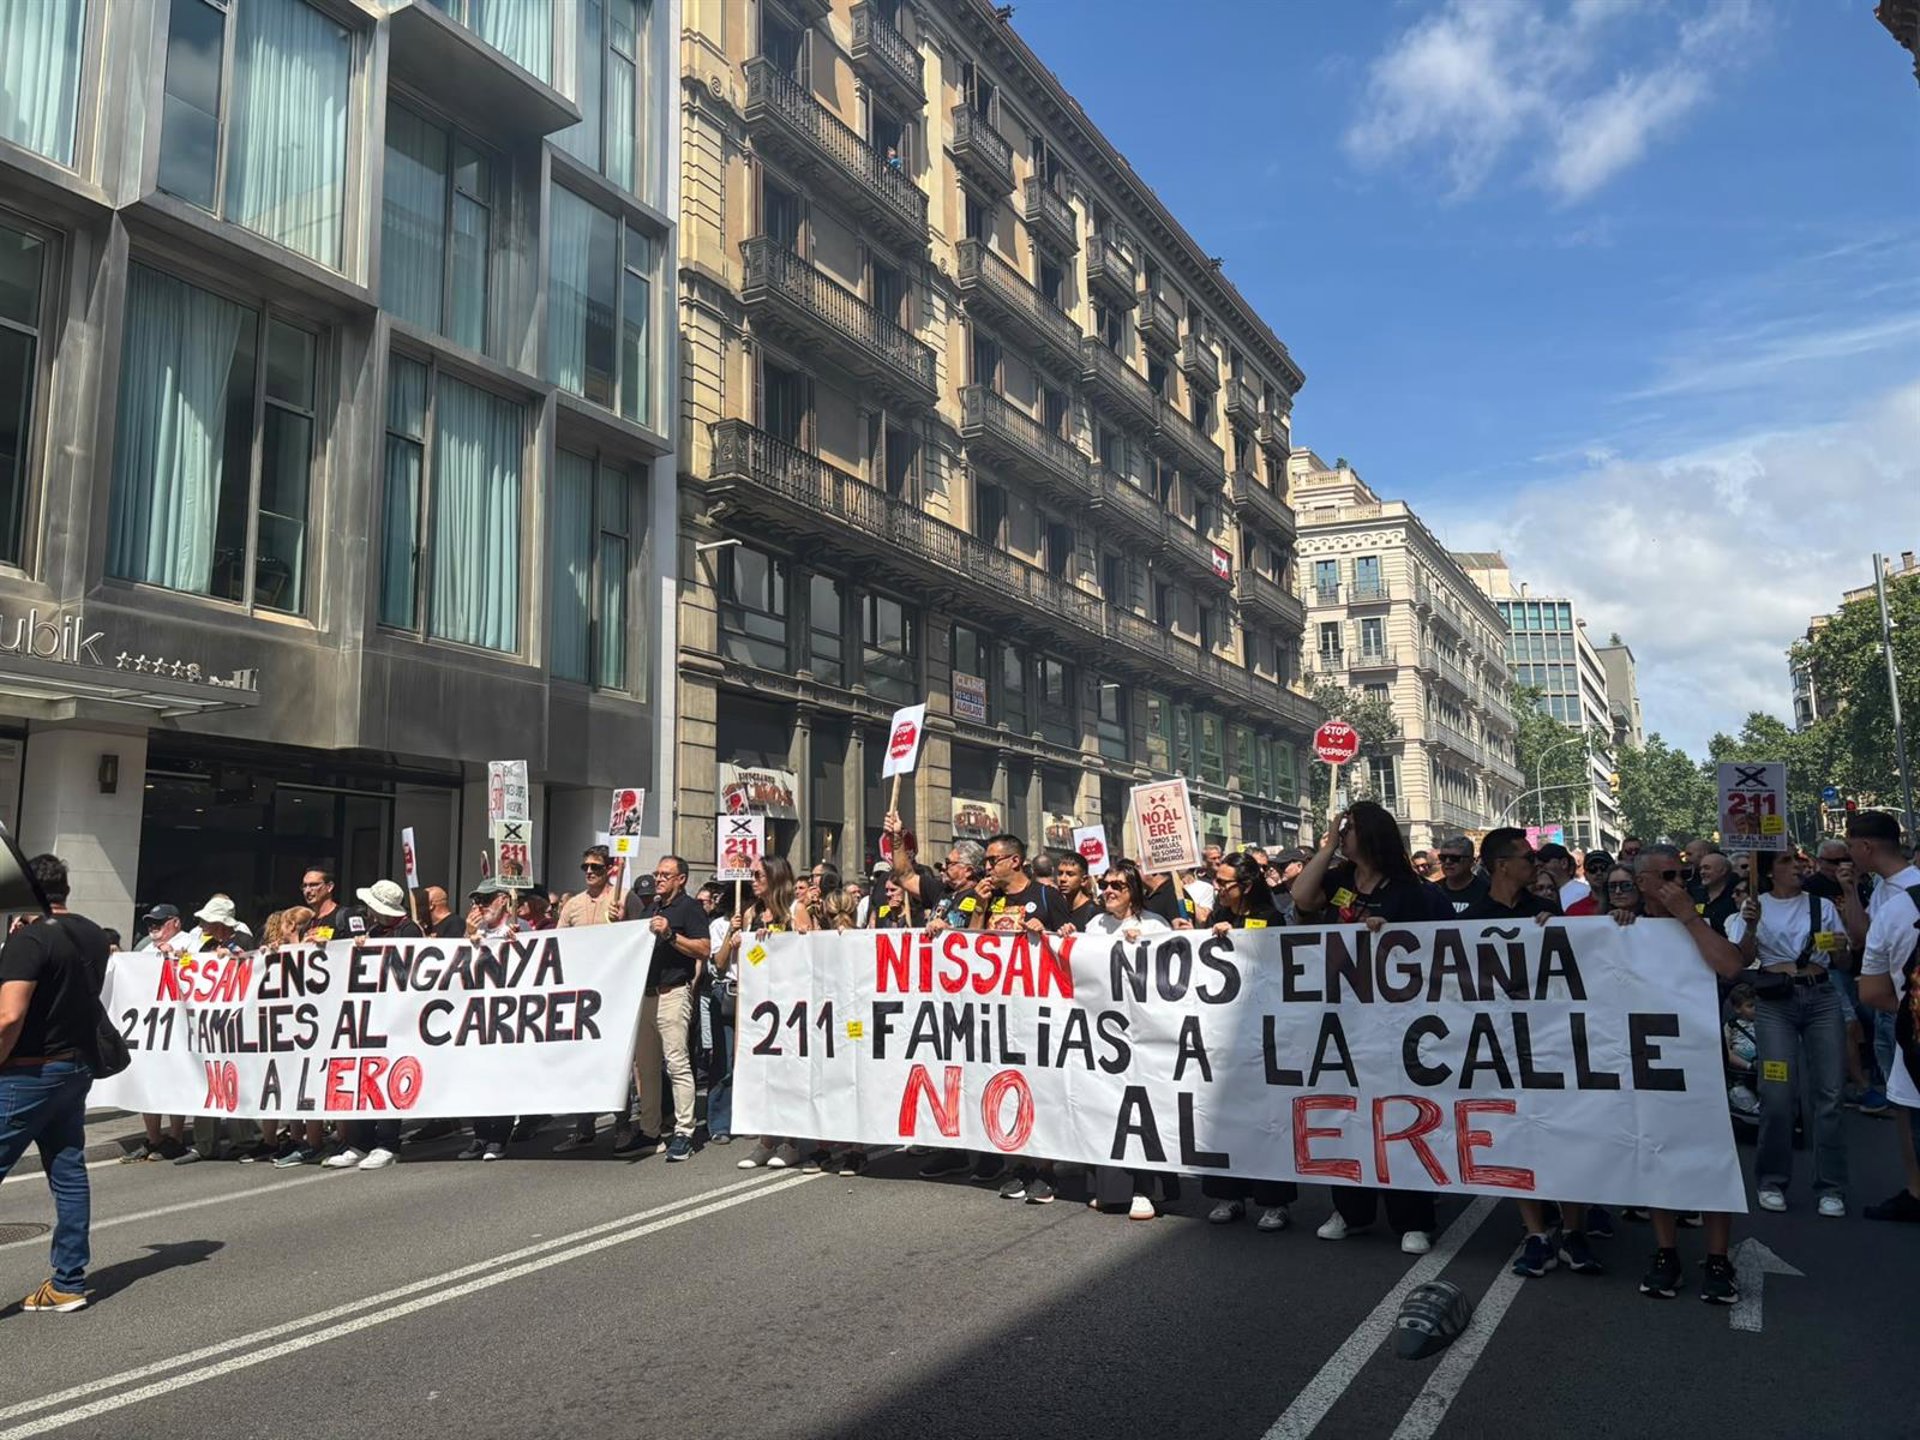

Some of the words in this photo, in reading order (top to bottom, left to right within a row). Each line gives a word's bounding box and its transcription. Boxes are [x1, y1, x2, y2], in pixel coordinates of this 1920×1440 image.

[1324, 726, 1350, 736] STOP
[1318, 747, 1353, 757] DESPIDOS
[1728, 792, 1776, 815] 211
[1142, 811, 1160, 826] NO
[1163, 808, 1182, 821] AL
[1148, 836, 1170, 846] SOMOS
[1171, 834, 1182, 843] 211
[1149, 822, 1177, 837] ERE
[501, 844, 528, 863] 211
[725, 838, 757, 855] 211
[258, 950, 331, 1000] ENS
[348, 936, 565, 994] ENGANYA
[1110, 934, 1242, 1005] NOS
[1279, 925, 1588, 1004] ENGAÑA
[121, 1006, 176, 1051] 211
[330, 999, 388, 1050] AL
[418, 989, 602, 1047] CARRER
[751, 1000, 835, 1057] 211
[1173, 1015, 1213, 1083] A
[1262, 1011, 1359, 1088] LA
[1401, 1011, 1687, 1092] CALLE
[203, 1059, 240, 1113] NO
[259, 1058, 282, 1112] A
[898, 1063, 1036, 1153] NO
[1110, 1085, 1231, 1170] AL
[1291, 1093, 1537, 1191] ERE
